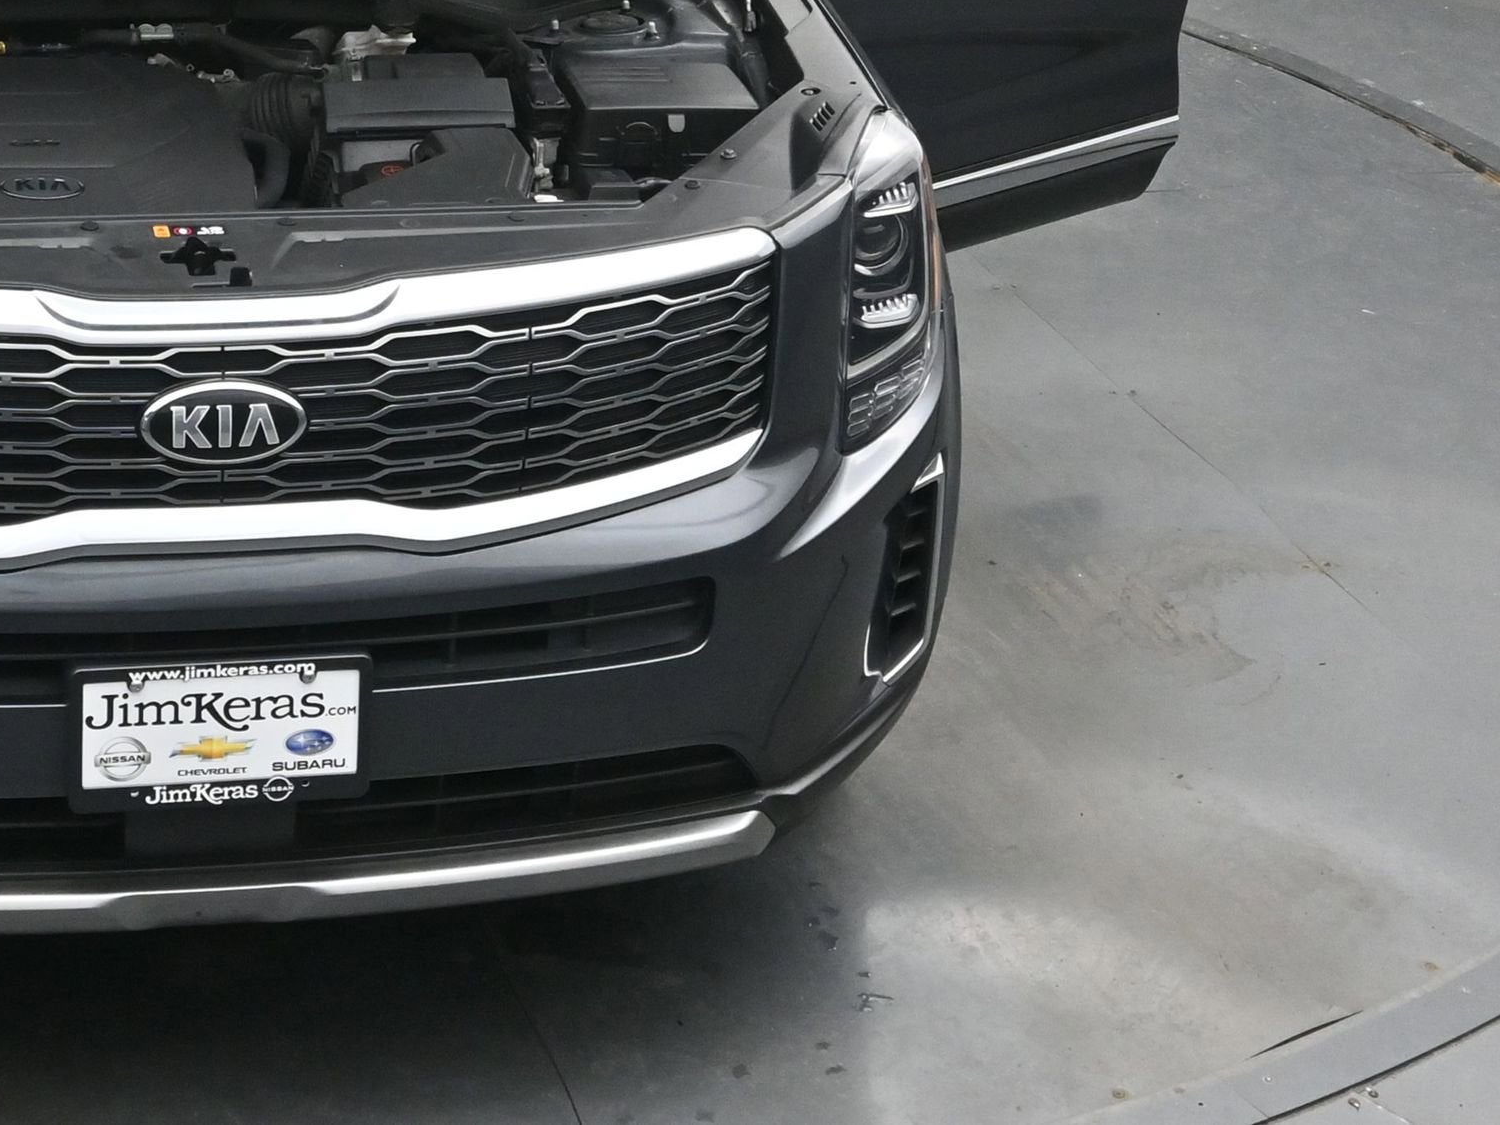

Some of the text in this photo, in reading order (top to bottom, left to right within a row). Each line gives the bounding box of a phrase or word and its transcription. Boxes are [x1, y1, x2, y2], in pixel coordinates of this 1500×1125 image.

[14, 177, 71, 191] KIA
[170, 403, 280, 449] KIA
[128, 662, 316, 684] www.jimkeras.com
[100, 754, 145, 765] NISSAN
[272, 758, 346, 772] SUBARU
[177, 766, 247, 777] CHEVROLET
[262, 785, 294, 793] NISSAN
